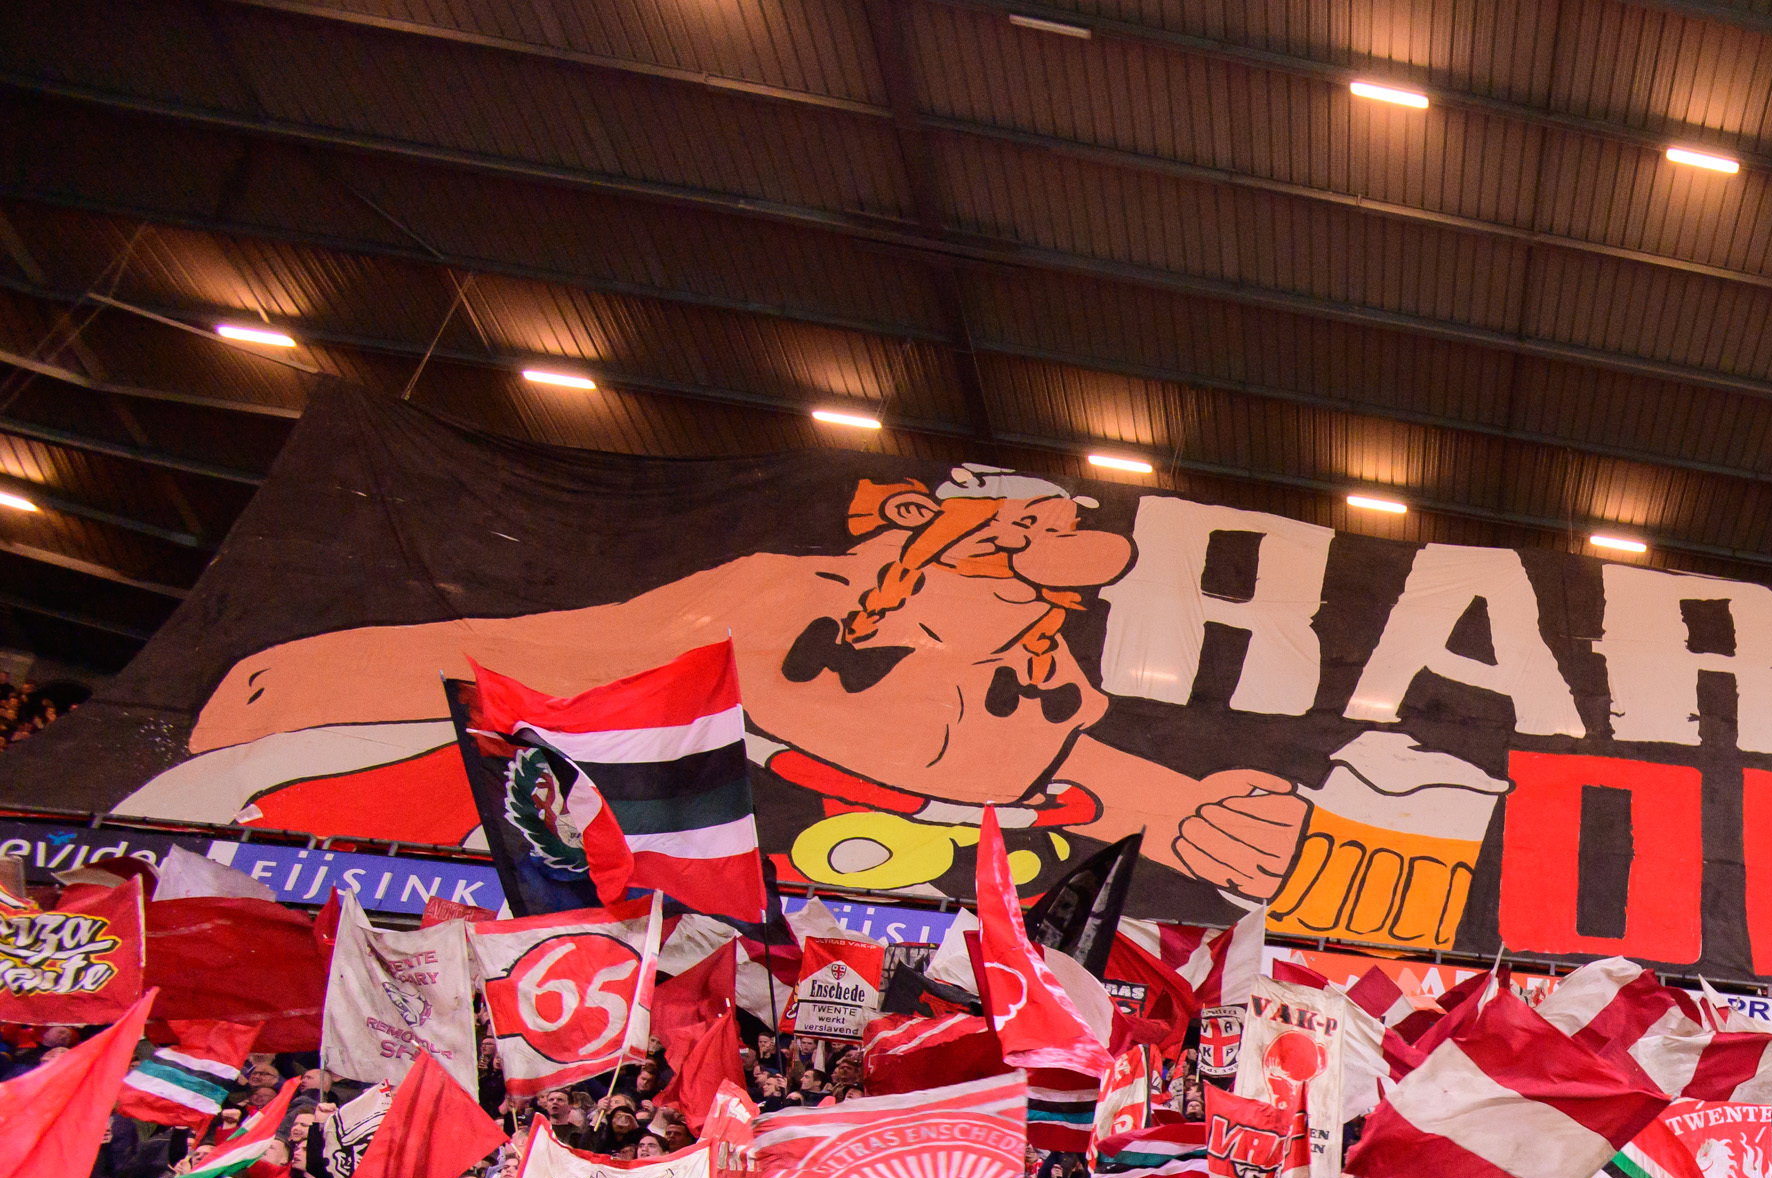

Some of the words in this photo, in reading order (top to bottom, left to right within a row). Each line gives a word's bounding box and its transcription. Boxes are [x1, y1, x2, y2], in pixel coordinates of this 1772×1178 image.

[517, 942, 640, 1060] 65
[810, 980, 865, 1003] Enschede
[812, 1004, 857, 1017] TWENTE
[818, 1015, 846, 1025] werkt
[1251, 994, 1338, 1037] VAK-P
[804, 1023, 859, 1035] verslavend
[1665, 1105, 1772, 1137] TWENTE
